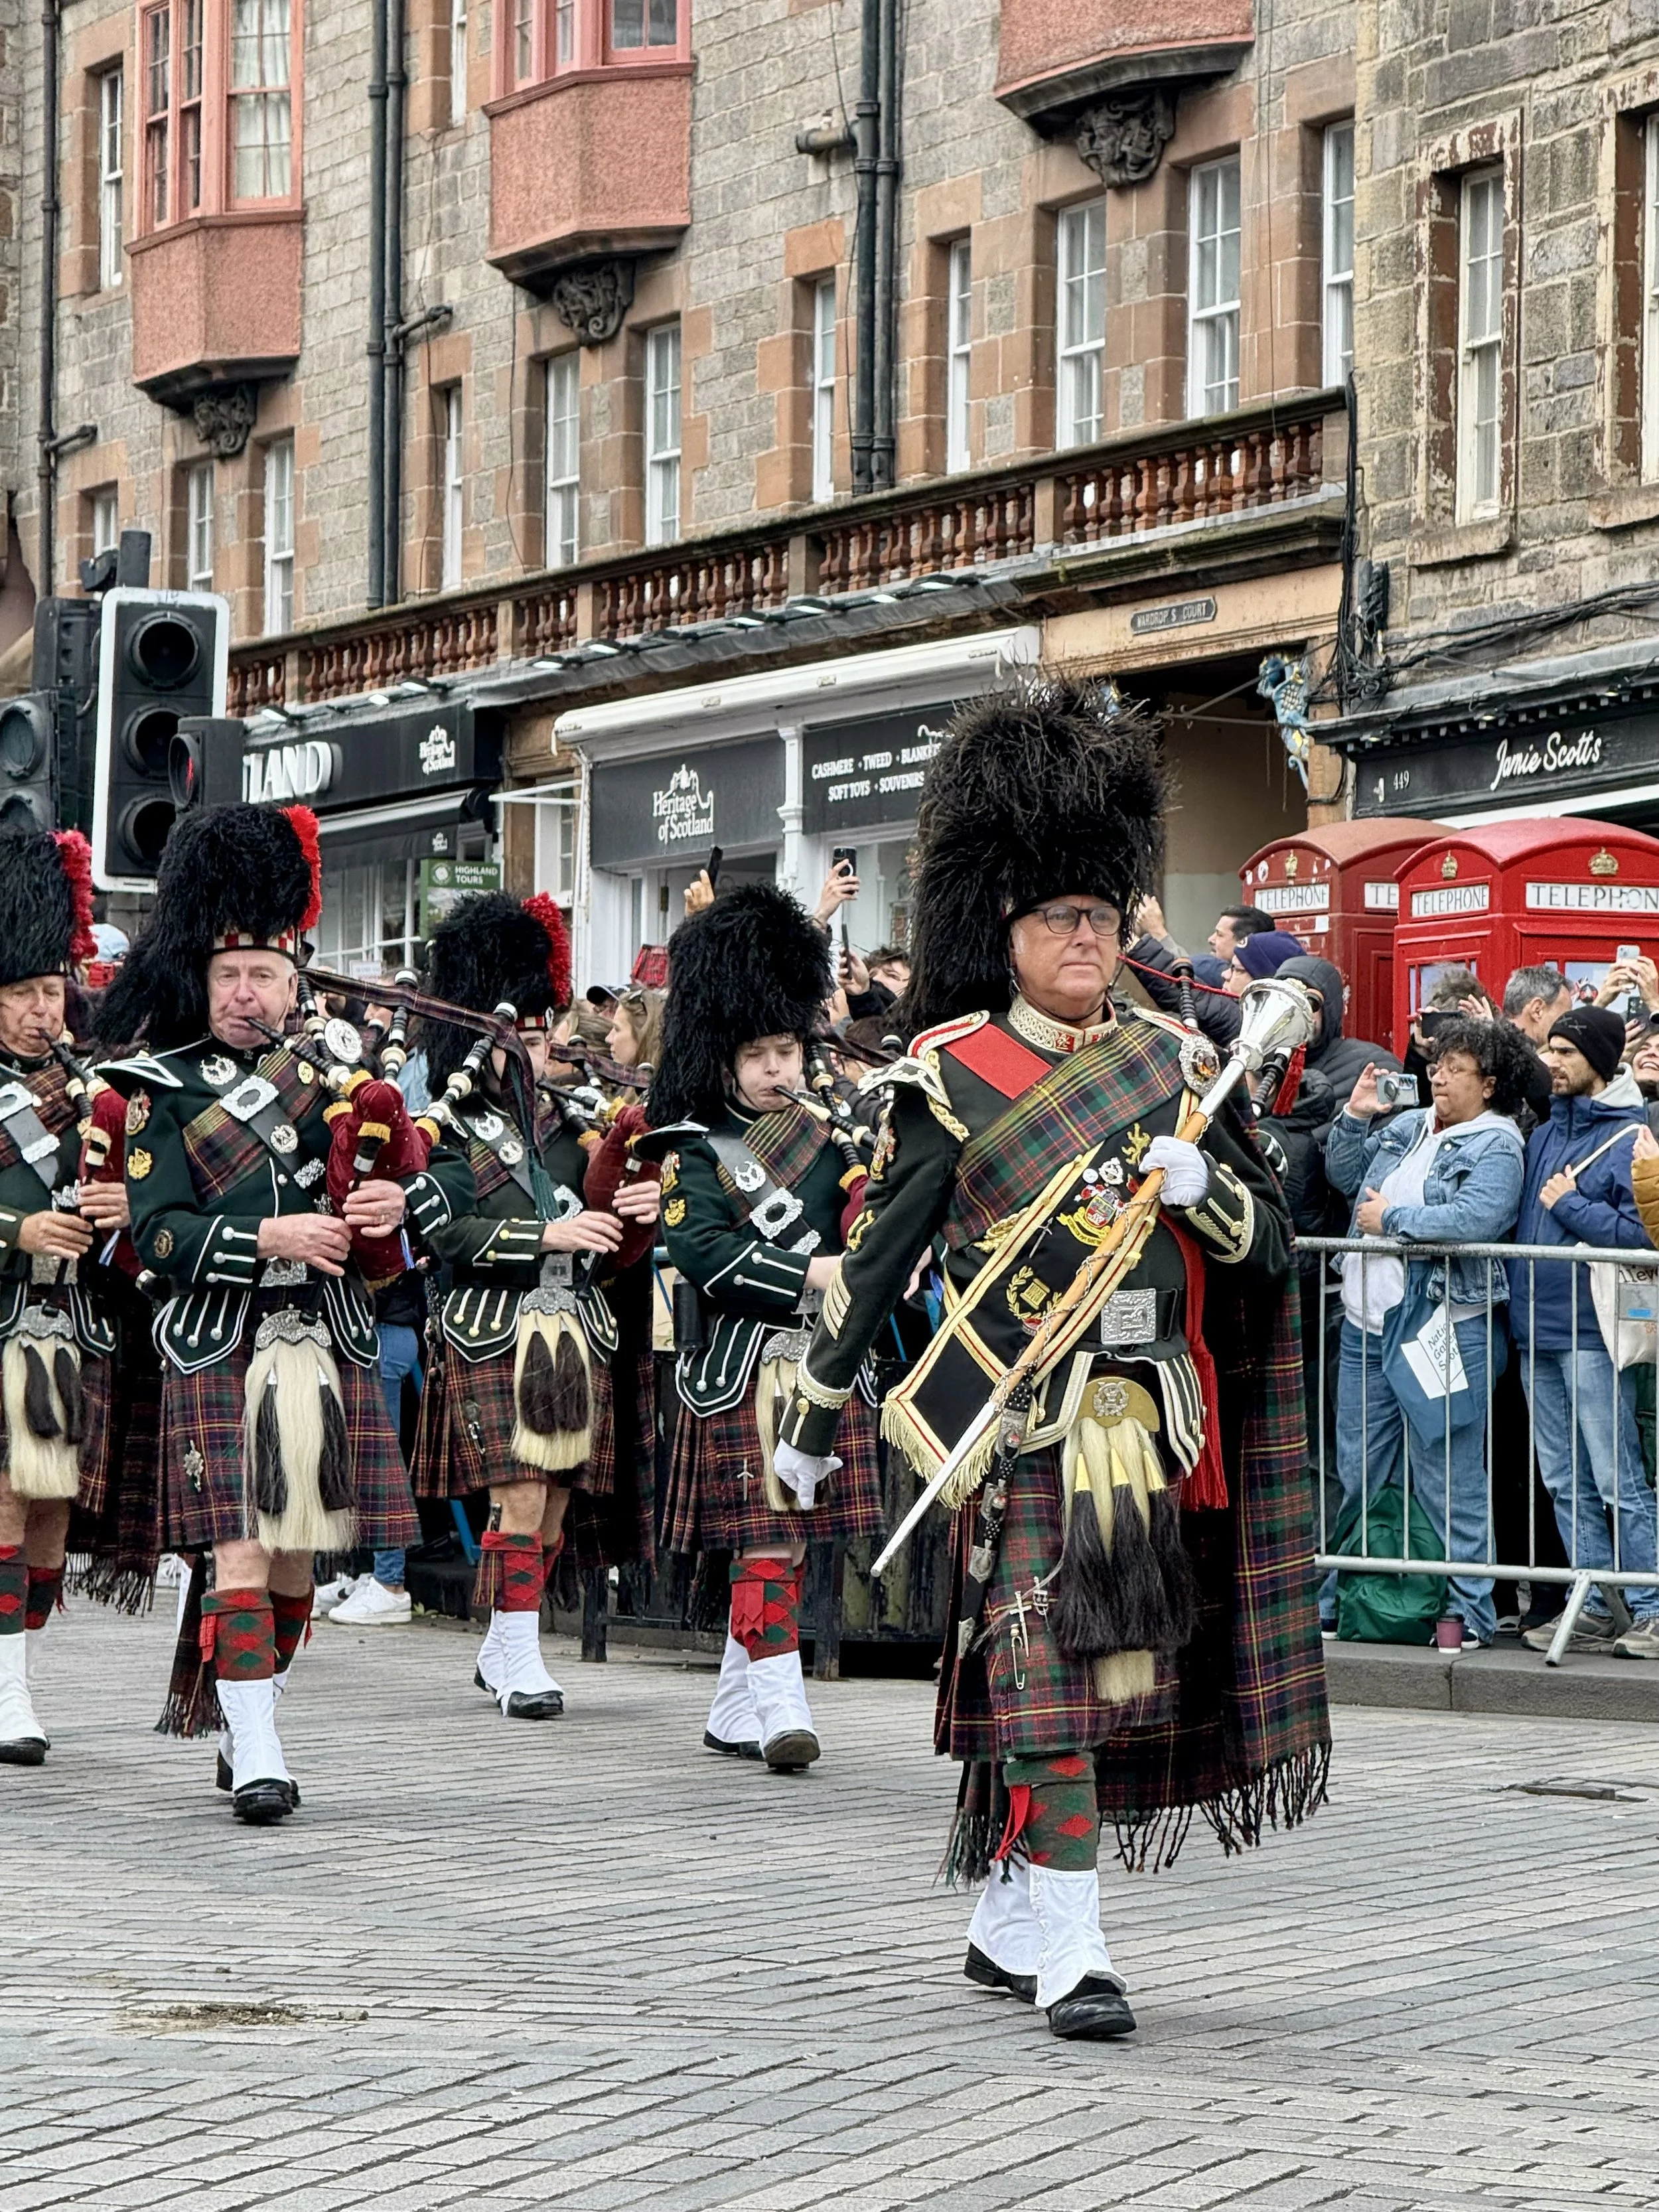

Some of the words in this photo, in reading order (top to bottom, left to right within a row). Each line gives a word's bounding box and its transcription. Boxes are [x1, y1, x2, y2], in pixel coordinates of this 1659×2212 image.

[1183, 602, 1207, 620] COURT
[812, 758, 855, 780] CASHMERE
[862, 751, 893, 771] TWEED
[1490, 738, 1542, 791] Jamie
[828, 783, 849, 802] SOFT
[849, 780, 871, 799] TOYS
[879, 771, 924, 794] SOUVENIRS
[1393, 770, 1410, 790] 449
[652, 791, 697, 818] Heritage
[658, 815, 670, 845] of
[669, 812, 714, 840] Scotland
[455, 865, 498, 876] HIGHLAND
[455, 875, 483, 885] TOURS
[1258, 885, 1327, 911] TELEPHONE
[1370, 884, 1399, 906] TE
[1415, 885, 1488, 915] TELEPHONE
[1532, 884, 1659, 910] TELEPHON
